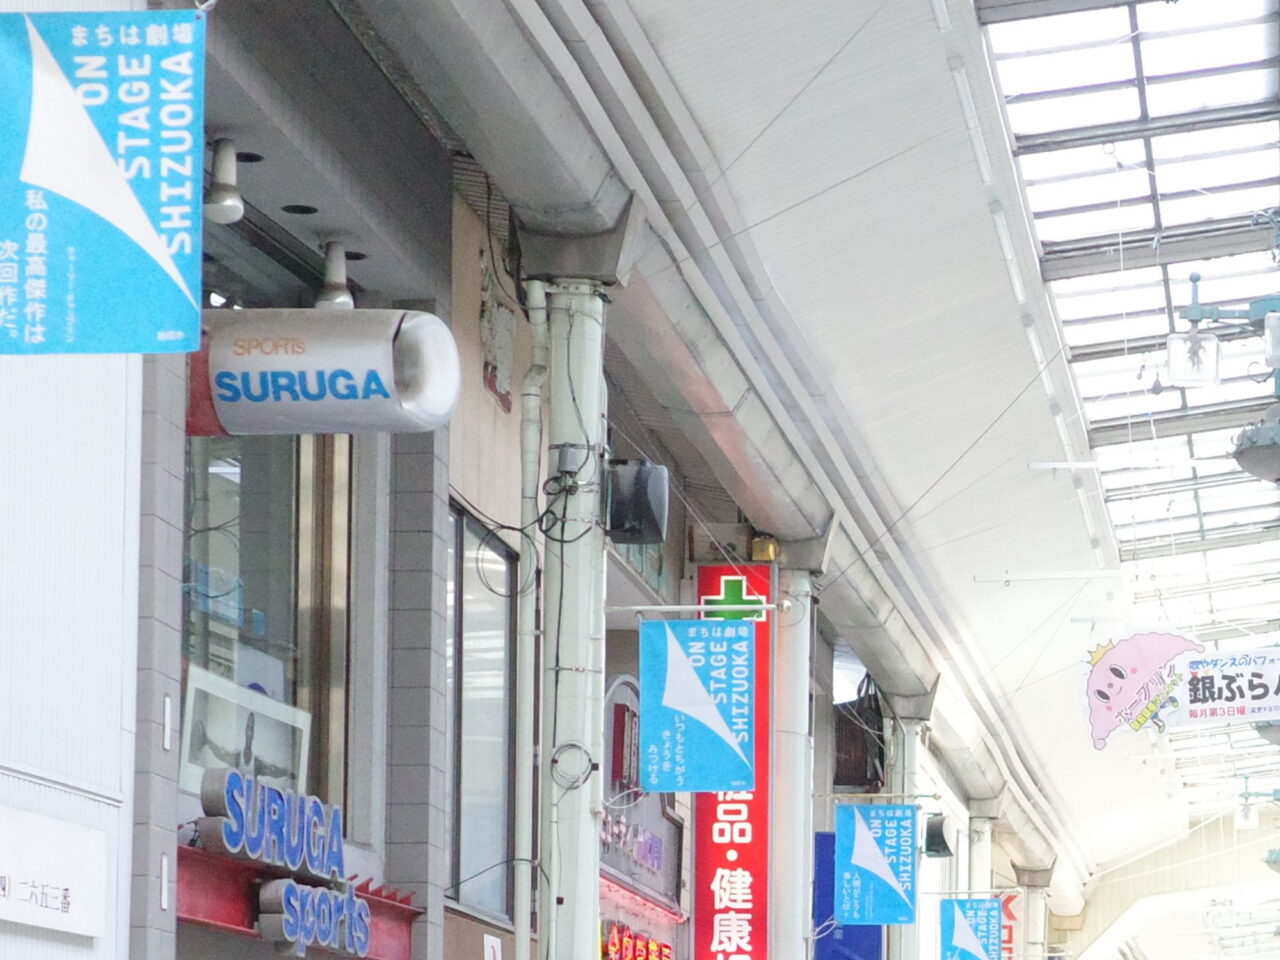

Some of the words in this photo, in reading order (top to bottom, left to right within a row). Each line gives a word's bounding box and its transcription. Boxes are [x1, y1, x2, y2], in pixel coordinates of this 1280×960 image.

[71, 23, 194, 46] まちは劇場
[75, 55, 109, 107] ON
[117, 54, 151, 180] STAGE
[159, 52, 193, 256] SHIZUOKA
[24, 189, 48, 344] 私の最高傑作は
[215, 369, 391, 403] SURUGA
[689, 641, 705, 667] ON
[710, 641, 727, 704] STAGE
[732, 641, 749, 742] SHIZUOKA
[1189, 705, 1246, 719] 毎月第3日曜
[221, 767, 347, 883] SURUGA
[870, 819, 882, 838] ON
[885, 819, 897, 864] STAGE
[899, 818, 913, 891] SHIZUOKA
